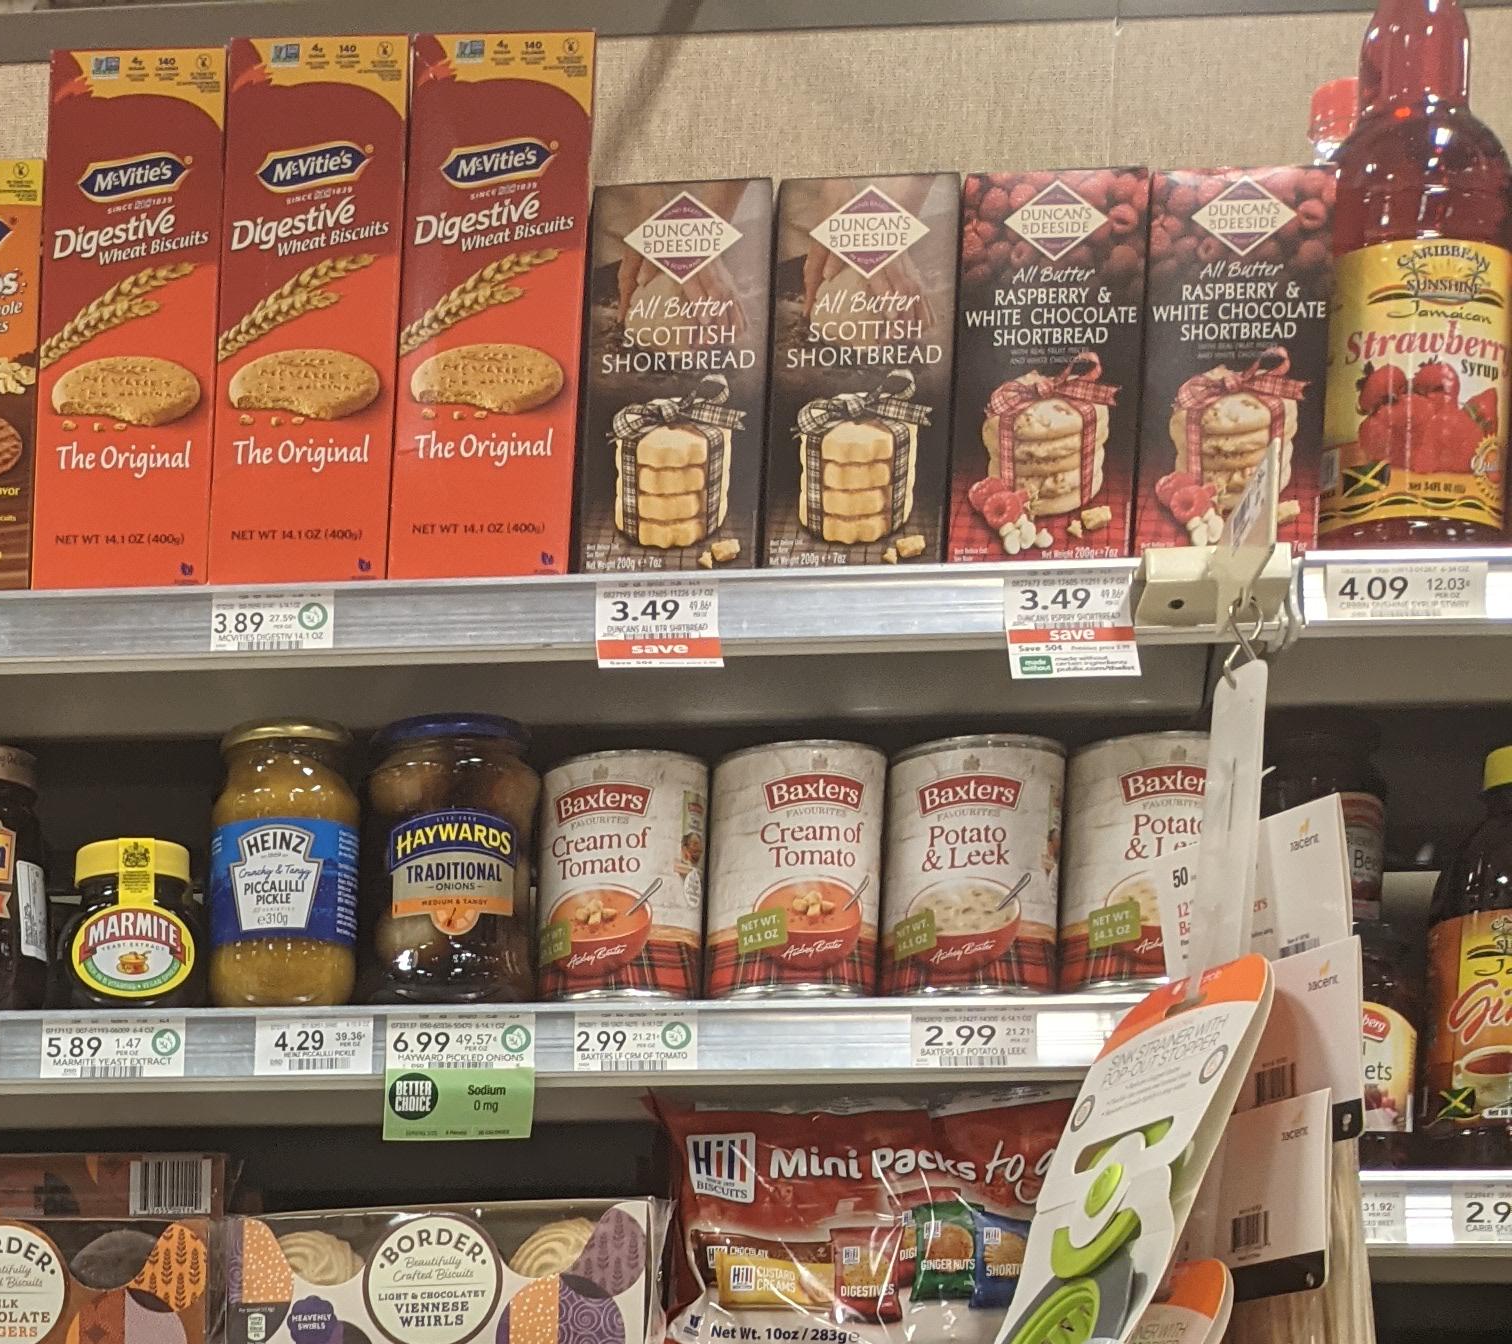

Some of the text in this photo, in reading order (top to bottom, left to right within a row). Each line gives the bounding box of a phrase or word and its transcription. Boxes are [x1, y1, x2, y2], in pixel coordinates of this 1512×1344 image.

[53, 206, 176, 260] Digestive
[642, 221, 724, 240] DUNCAN'S
[652, 236, 721, 254] DEESIDE
[994, 286, 1091, 306] RASPBERRY
[965, 306, 1138, 326] WHITE CHOCOLATE
[623, 325, 736, 348] SCOTTISH
[601, 349, 756, 374] SHORTBREAD
[1461, 360, 1500, 381] Syrup
[56, 443, 191, 478] The Original
[1338, 577, 1409, 601] 4.09
[610, 602, 680, 622] 3.49
[213, 612, 264, 633] 3.89
[631, 642, 688, 656] save
[558, 790, 644, 817] Baxters
[245, 831, 305, 856] HEINZ
[396, 823, 512, 857] HAYWARDS
[552, 827, 650, 858] Cream of
[928, 824, 1007, 848] Potato
[946, 843, 1010, 869] Leek
[406, 864, 503, 883] TRADITIONAL
[557, 856, 641, 880] Tomato
[244, 882, 305, 895] PICCALILLI
[256, 893, 291, 905] PICKLE
[88, 913, 181, 946] MARMITE
[46, 1038, 141, 1057] 5.89 1.47
[52, 1056, 171, 1067] MARMITE YEAST EXTRACT
[395, 1081, 433, 1097] BETTER
[467, 1084, 507, 1097] Sodium
[394, 1096, 432, 1113] CHOICE
[770, 1147, 976, 1180] Mini Packs
[394, 1301, 469, 1314] VIENNESE
[399, 1313, 464, 1328] WHIRLS
